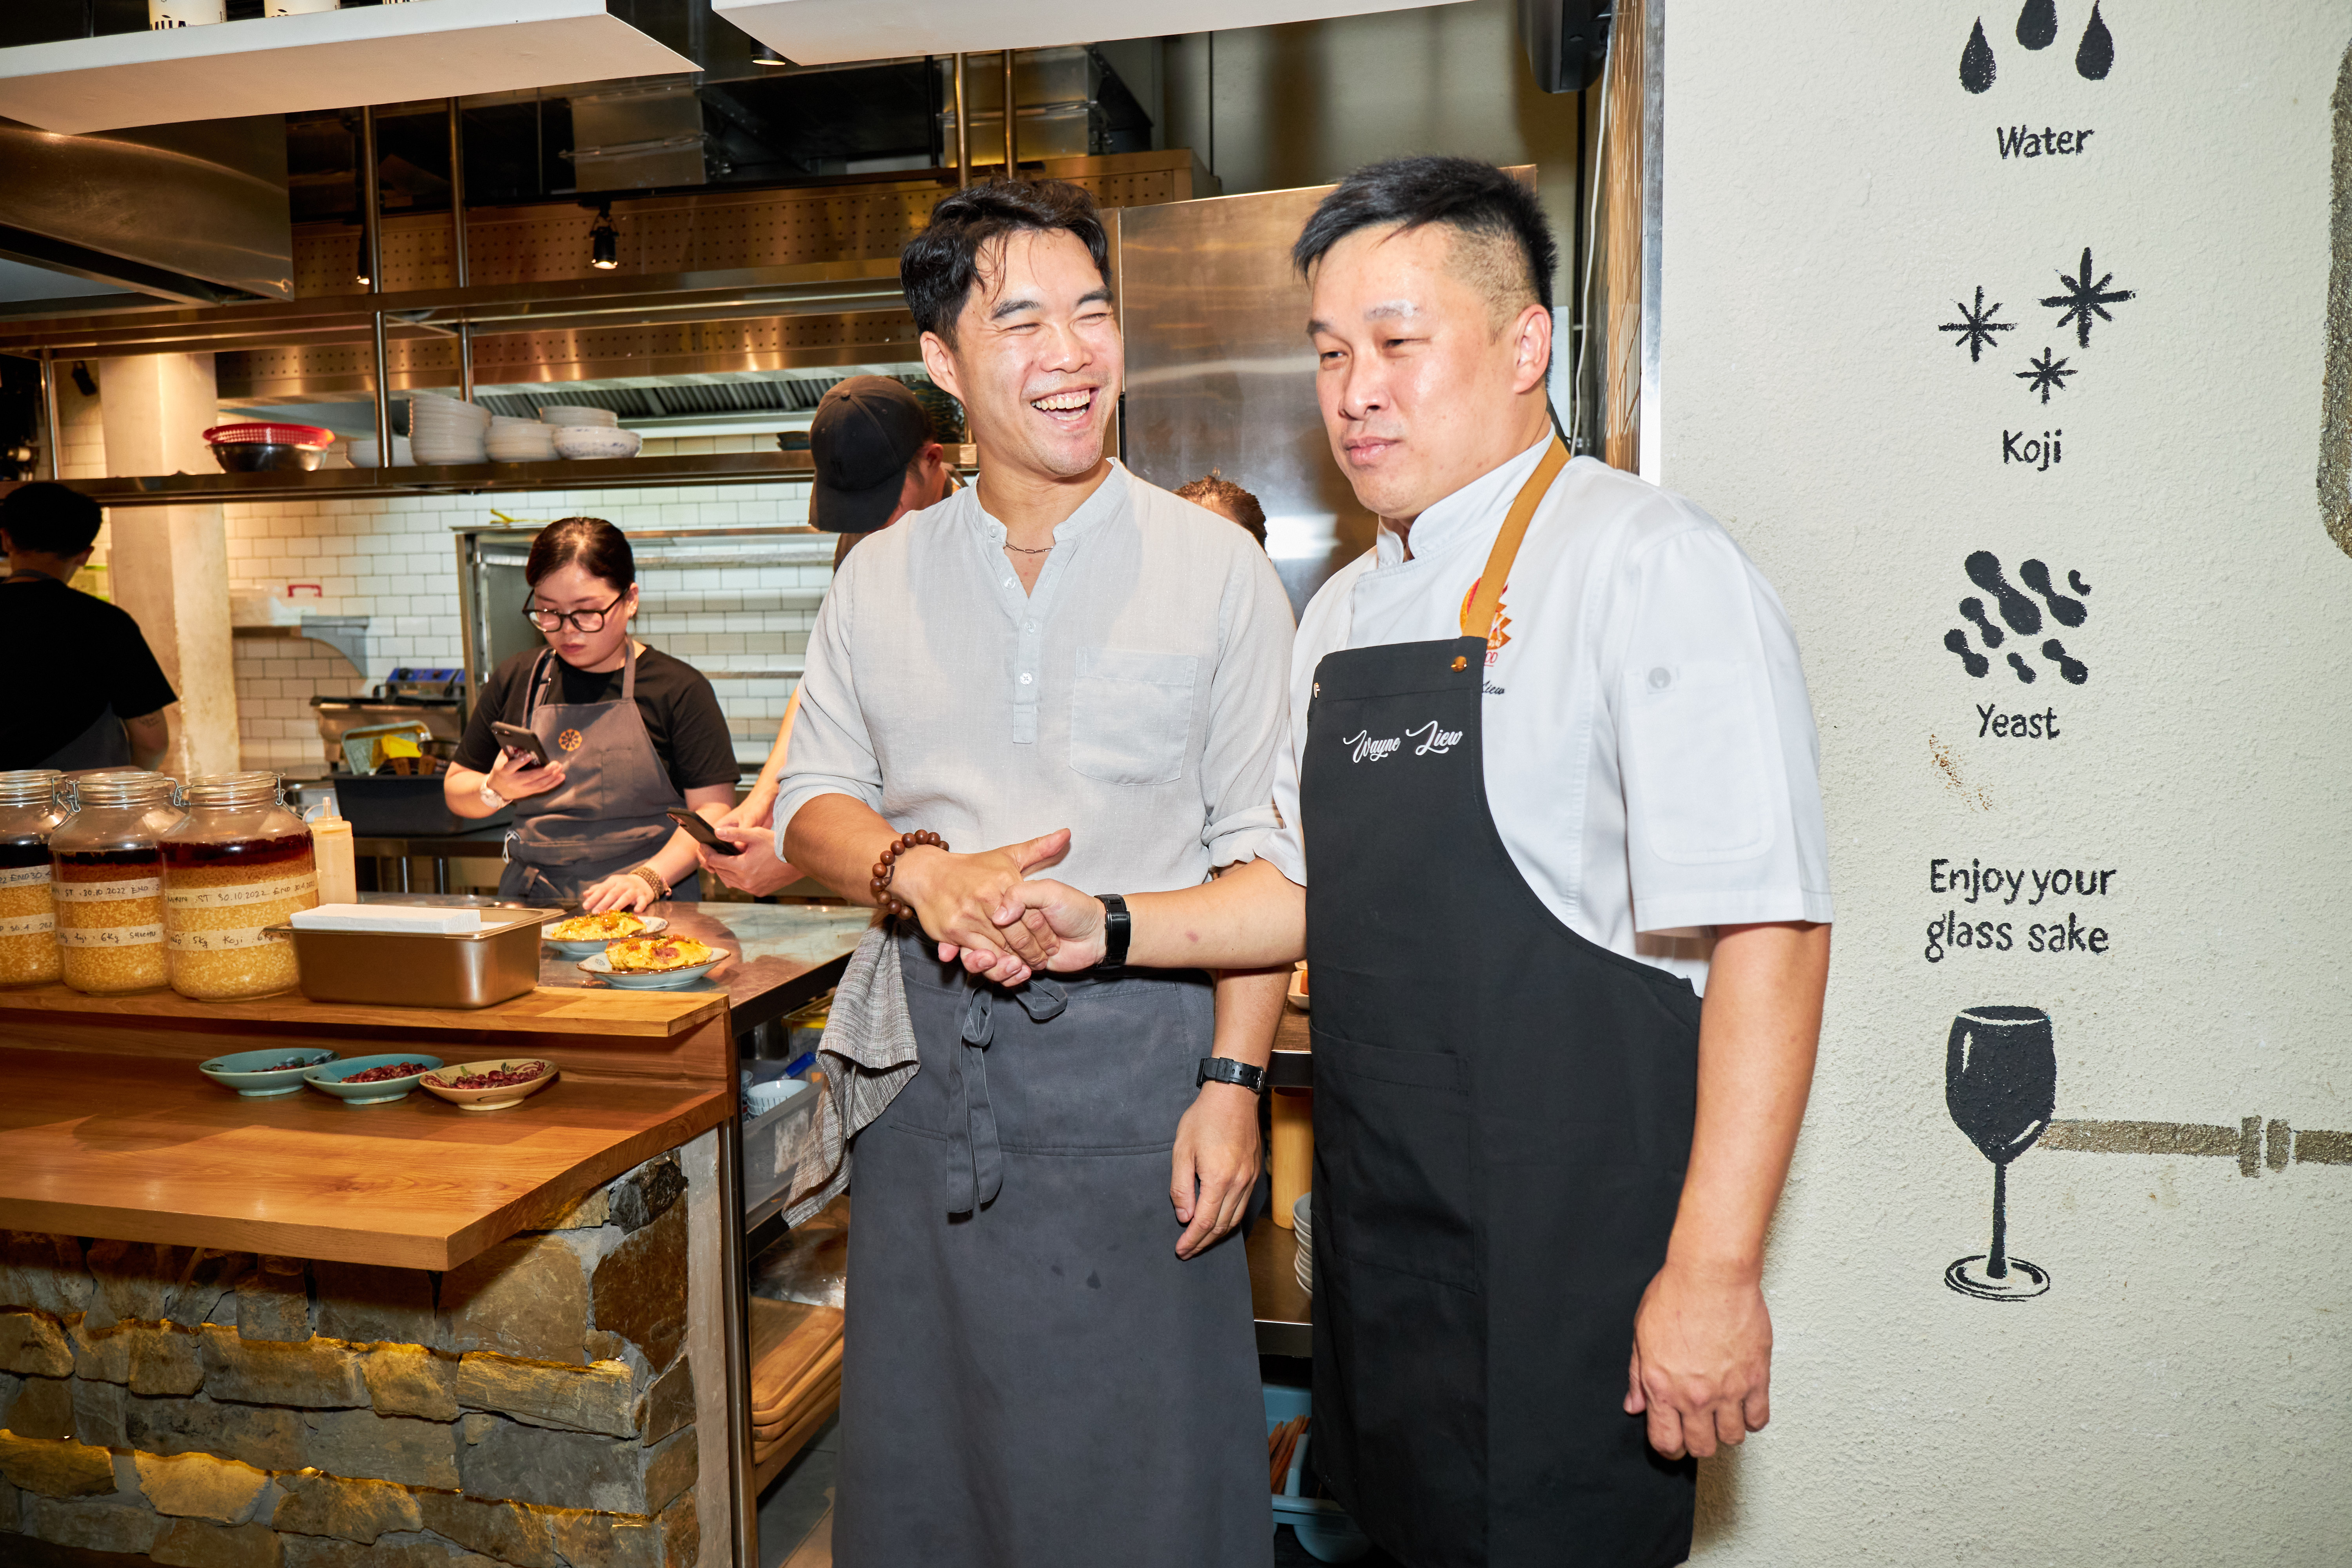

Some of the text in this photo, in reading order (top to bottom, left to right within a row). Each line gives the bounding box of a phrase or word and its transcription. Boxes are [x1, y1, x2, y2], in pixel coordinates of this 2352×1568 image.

[1996, 124, 2095, 160] Water
[2002, 428, 2062, 472] Koji
[1343, 720, 1463, 764] Wayne Liew
[1976, 703, 2061, 740] Yeast
[1930, 858, 2118, 906] Enjoy your
[1925, 909, 2109, 964] glass sake
